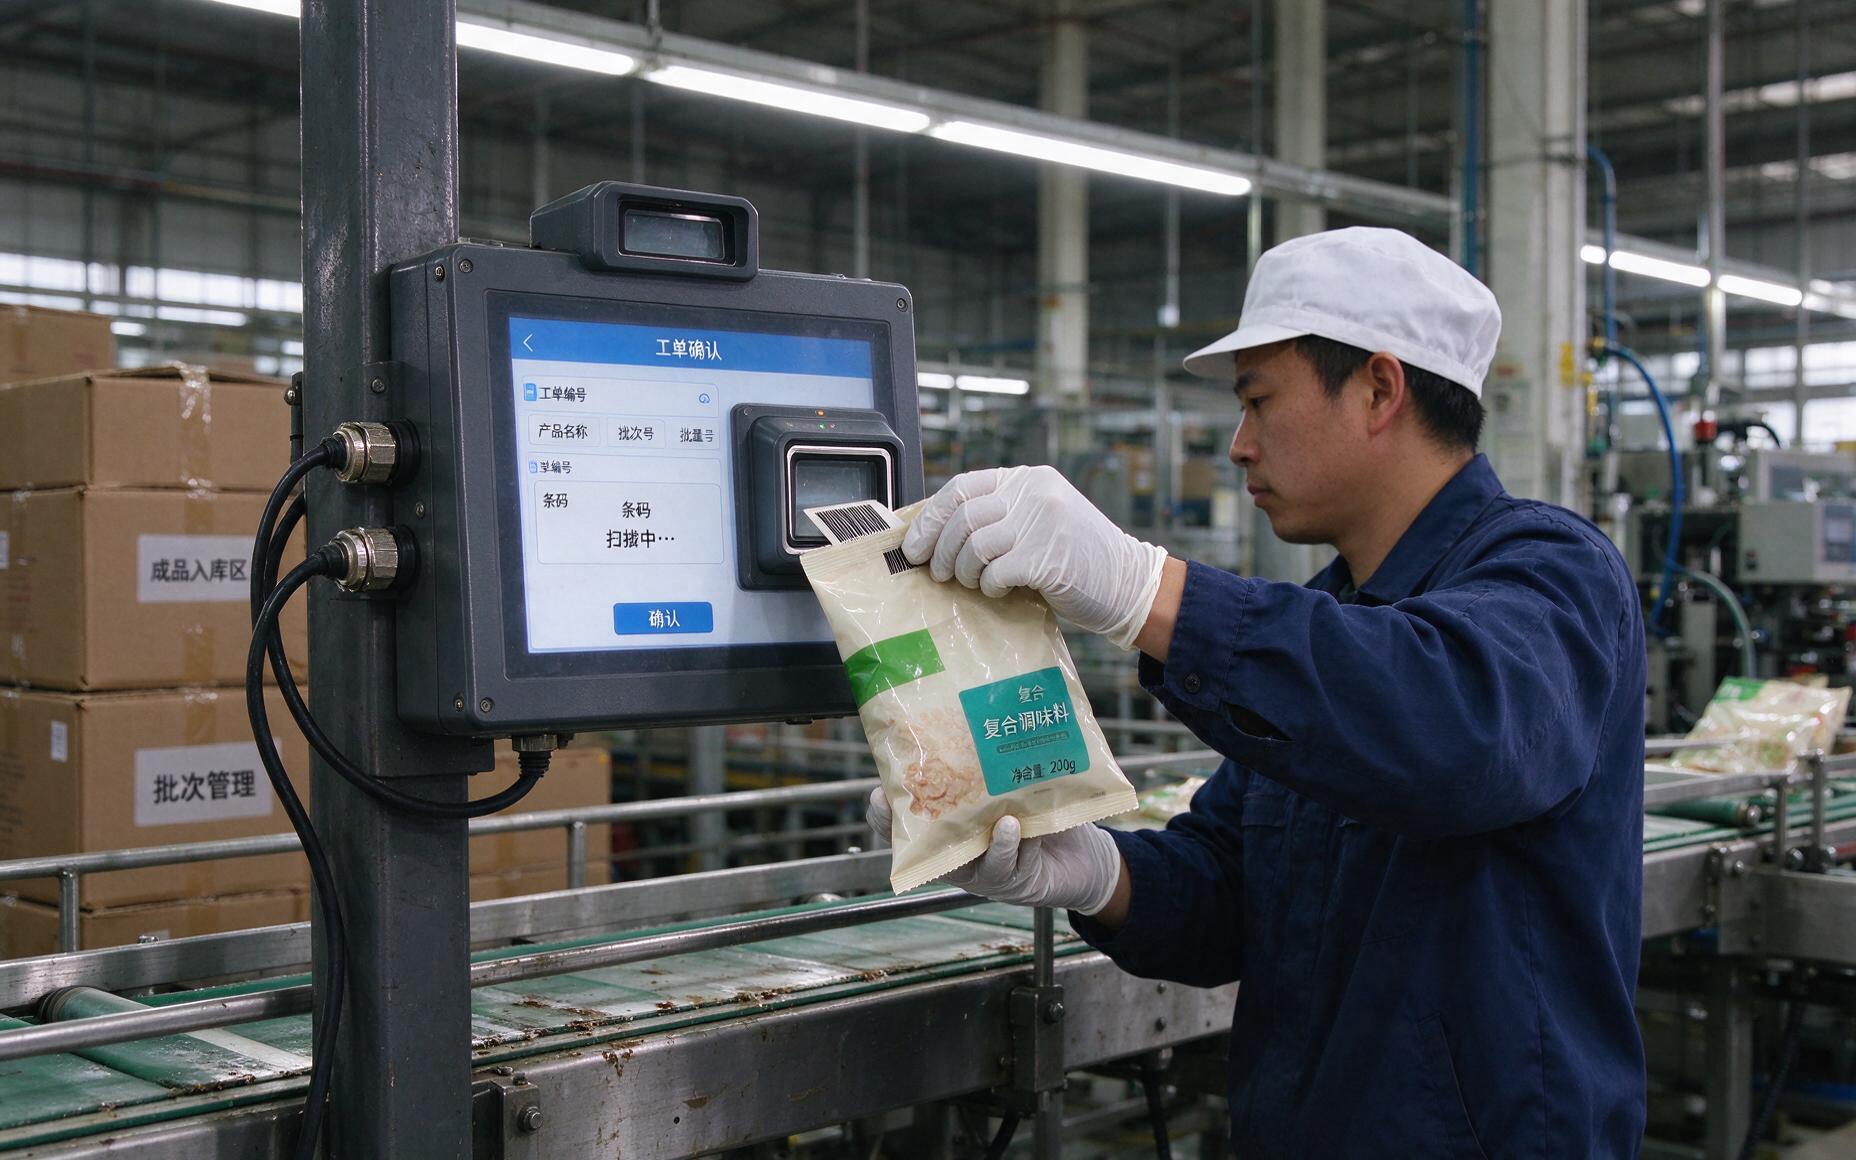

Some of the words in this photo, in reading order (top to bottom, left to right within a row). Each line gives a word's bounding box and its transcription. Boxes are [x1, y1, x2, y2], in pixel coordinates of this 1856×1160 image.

[655, 338, 722, 361] 工单确认
[539, 386, 587, 402] 工单编号
[538, 423, 588, 440] 产品名称
[618, 425, 654, 441] 批次号
[543, 493, 568, 508] 条码
[622, 501, 651, 519] 条码
[150, 558, 248, 583] 成品入库区
[648, 609, 680, 628] 确认
[1018, 684, 1046, 703] 复合
[983, 702, 1070, 739] 复合调味料
[1050, 759, 1076, 774] 200g
[153, 769, 256, 804] 批次管理
